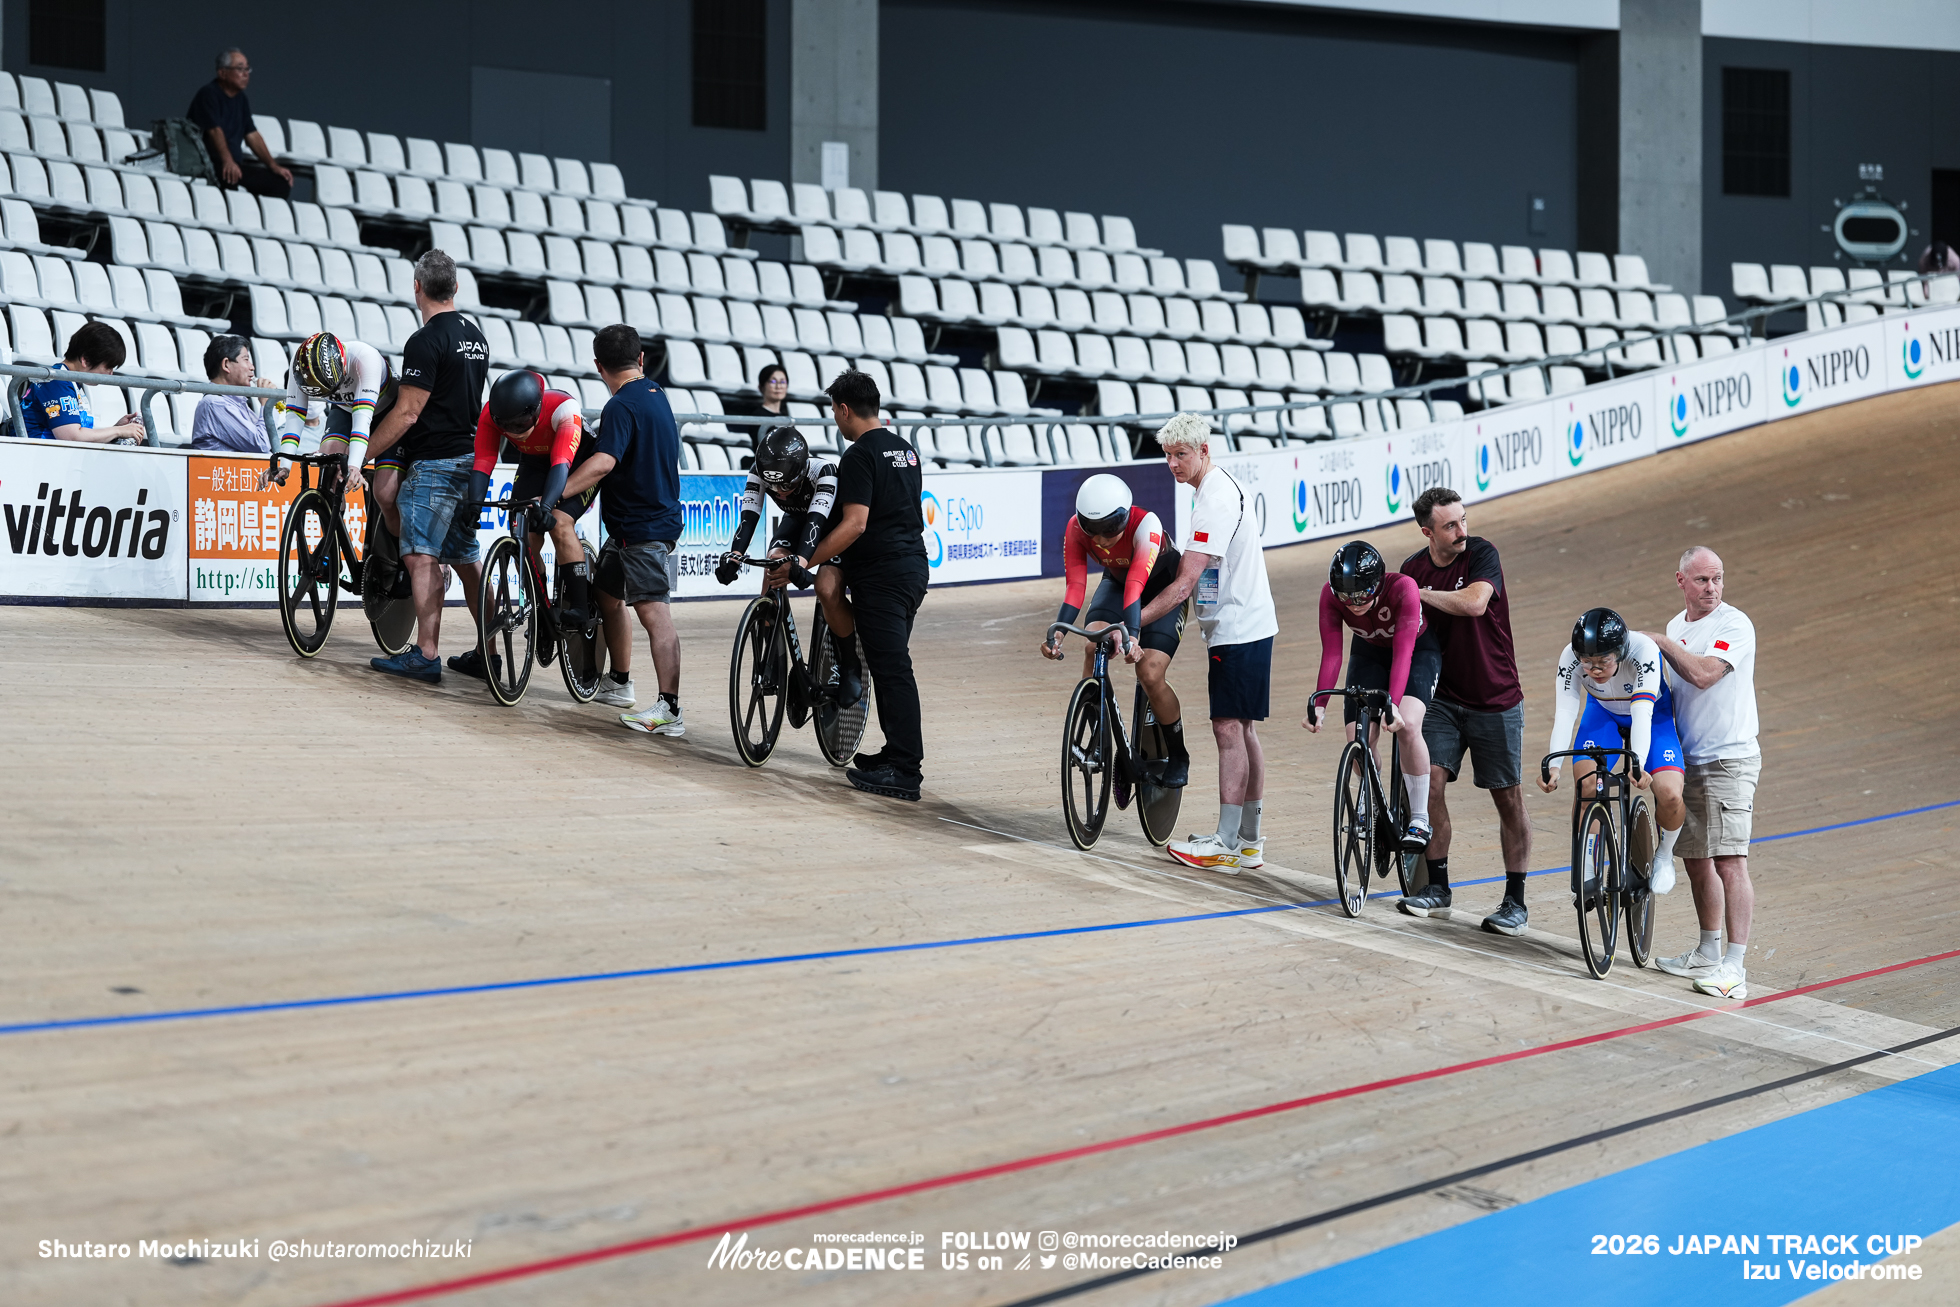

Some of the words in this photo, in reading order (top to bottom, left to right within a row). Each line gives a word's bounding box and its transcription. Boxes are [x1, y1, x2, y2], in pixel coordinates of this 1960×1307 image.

[1807, 344, 1871, 392] NIPPO
[1693, 371, 1752, 423] NIPPO
[1494, 426, 1543, 476] NIPPO
[1588, 402, 1643, 451] NIPPO
[3, 482, 170, 560] vittoria
[715, 499, 731, 543] to
[1313, 477, 1362, 528] NIPPO
[1564, 659, 1580, 691] TROXUS
[1631, 658, 1644, 688] TROXUS
